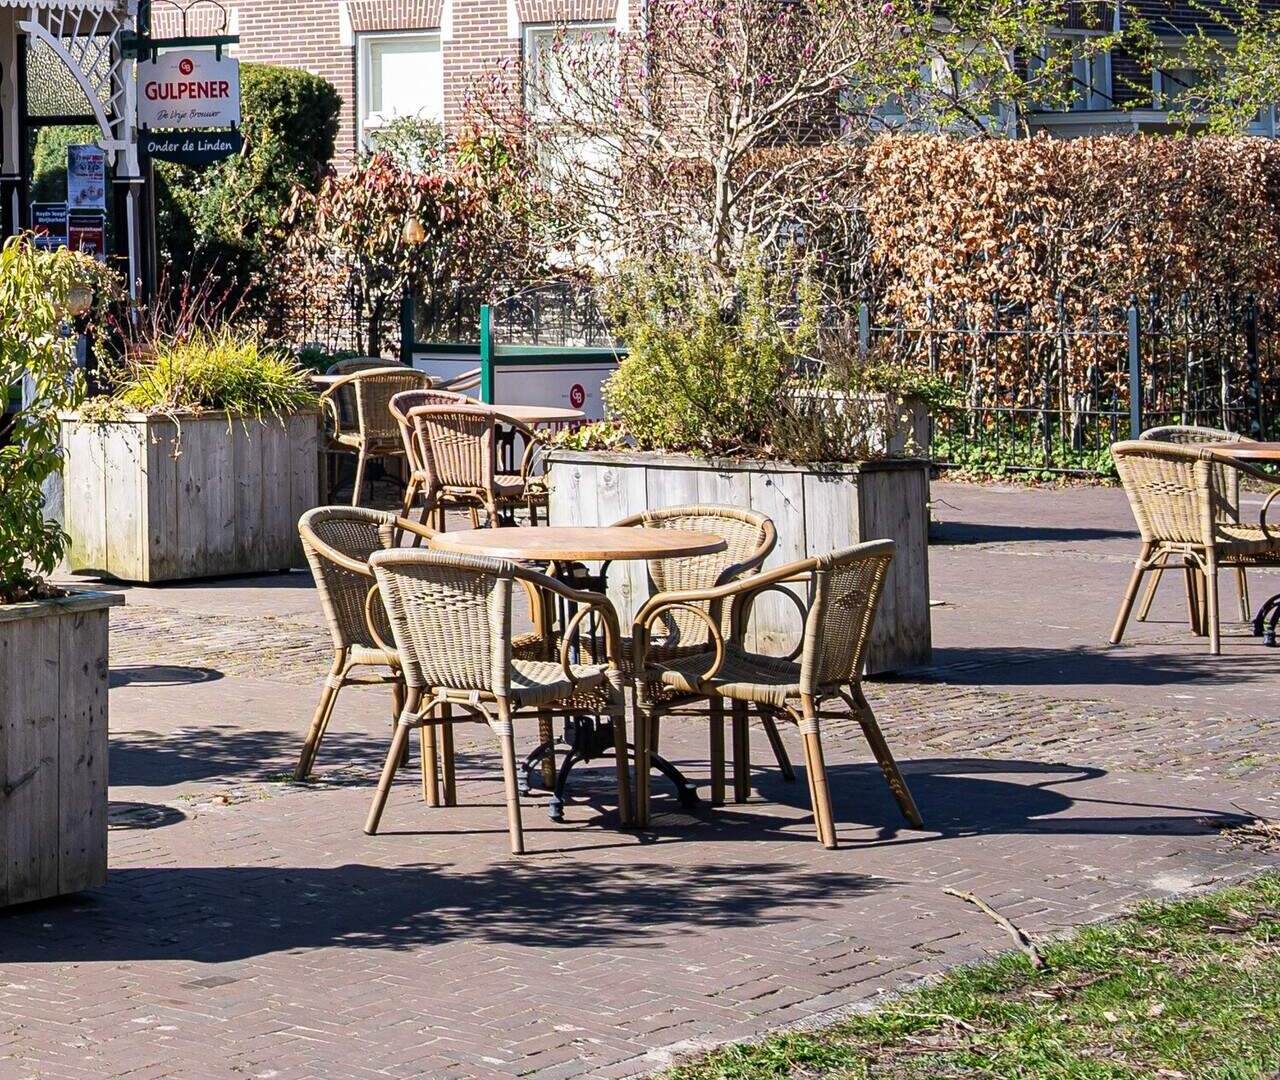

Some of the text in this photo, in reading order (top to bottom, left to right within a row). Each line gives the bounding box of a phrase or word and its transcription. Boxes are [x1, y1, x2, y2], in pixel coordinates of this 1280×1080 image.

[145, 80, 230, 101] GULPENER
[157, 109, 169, 121] De
[147, 139, 233, 153] Onder de Linden
